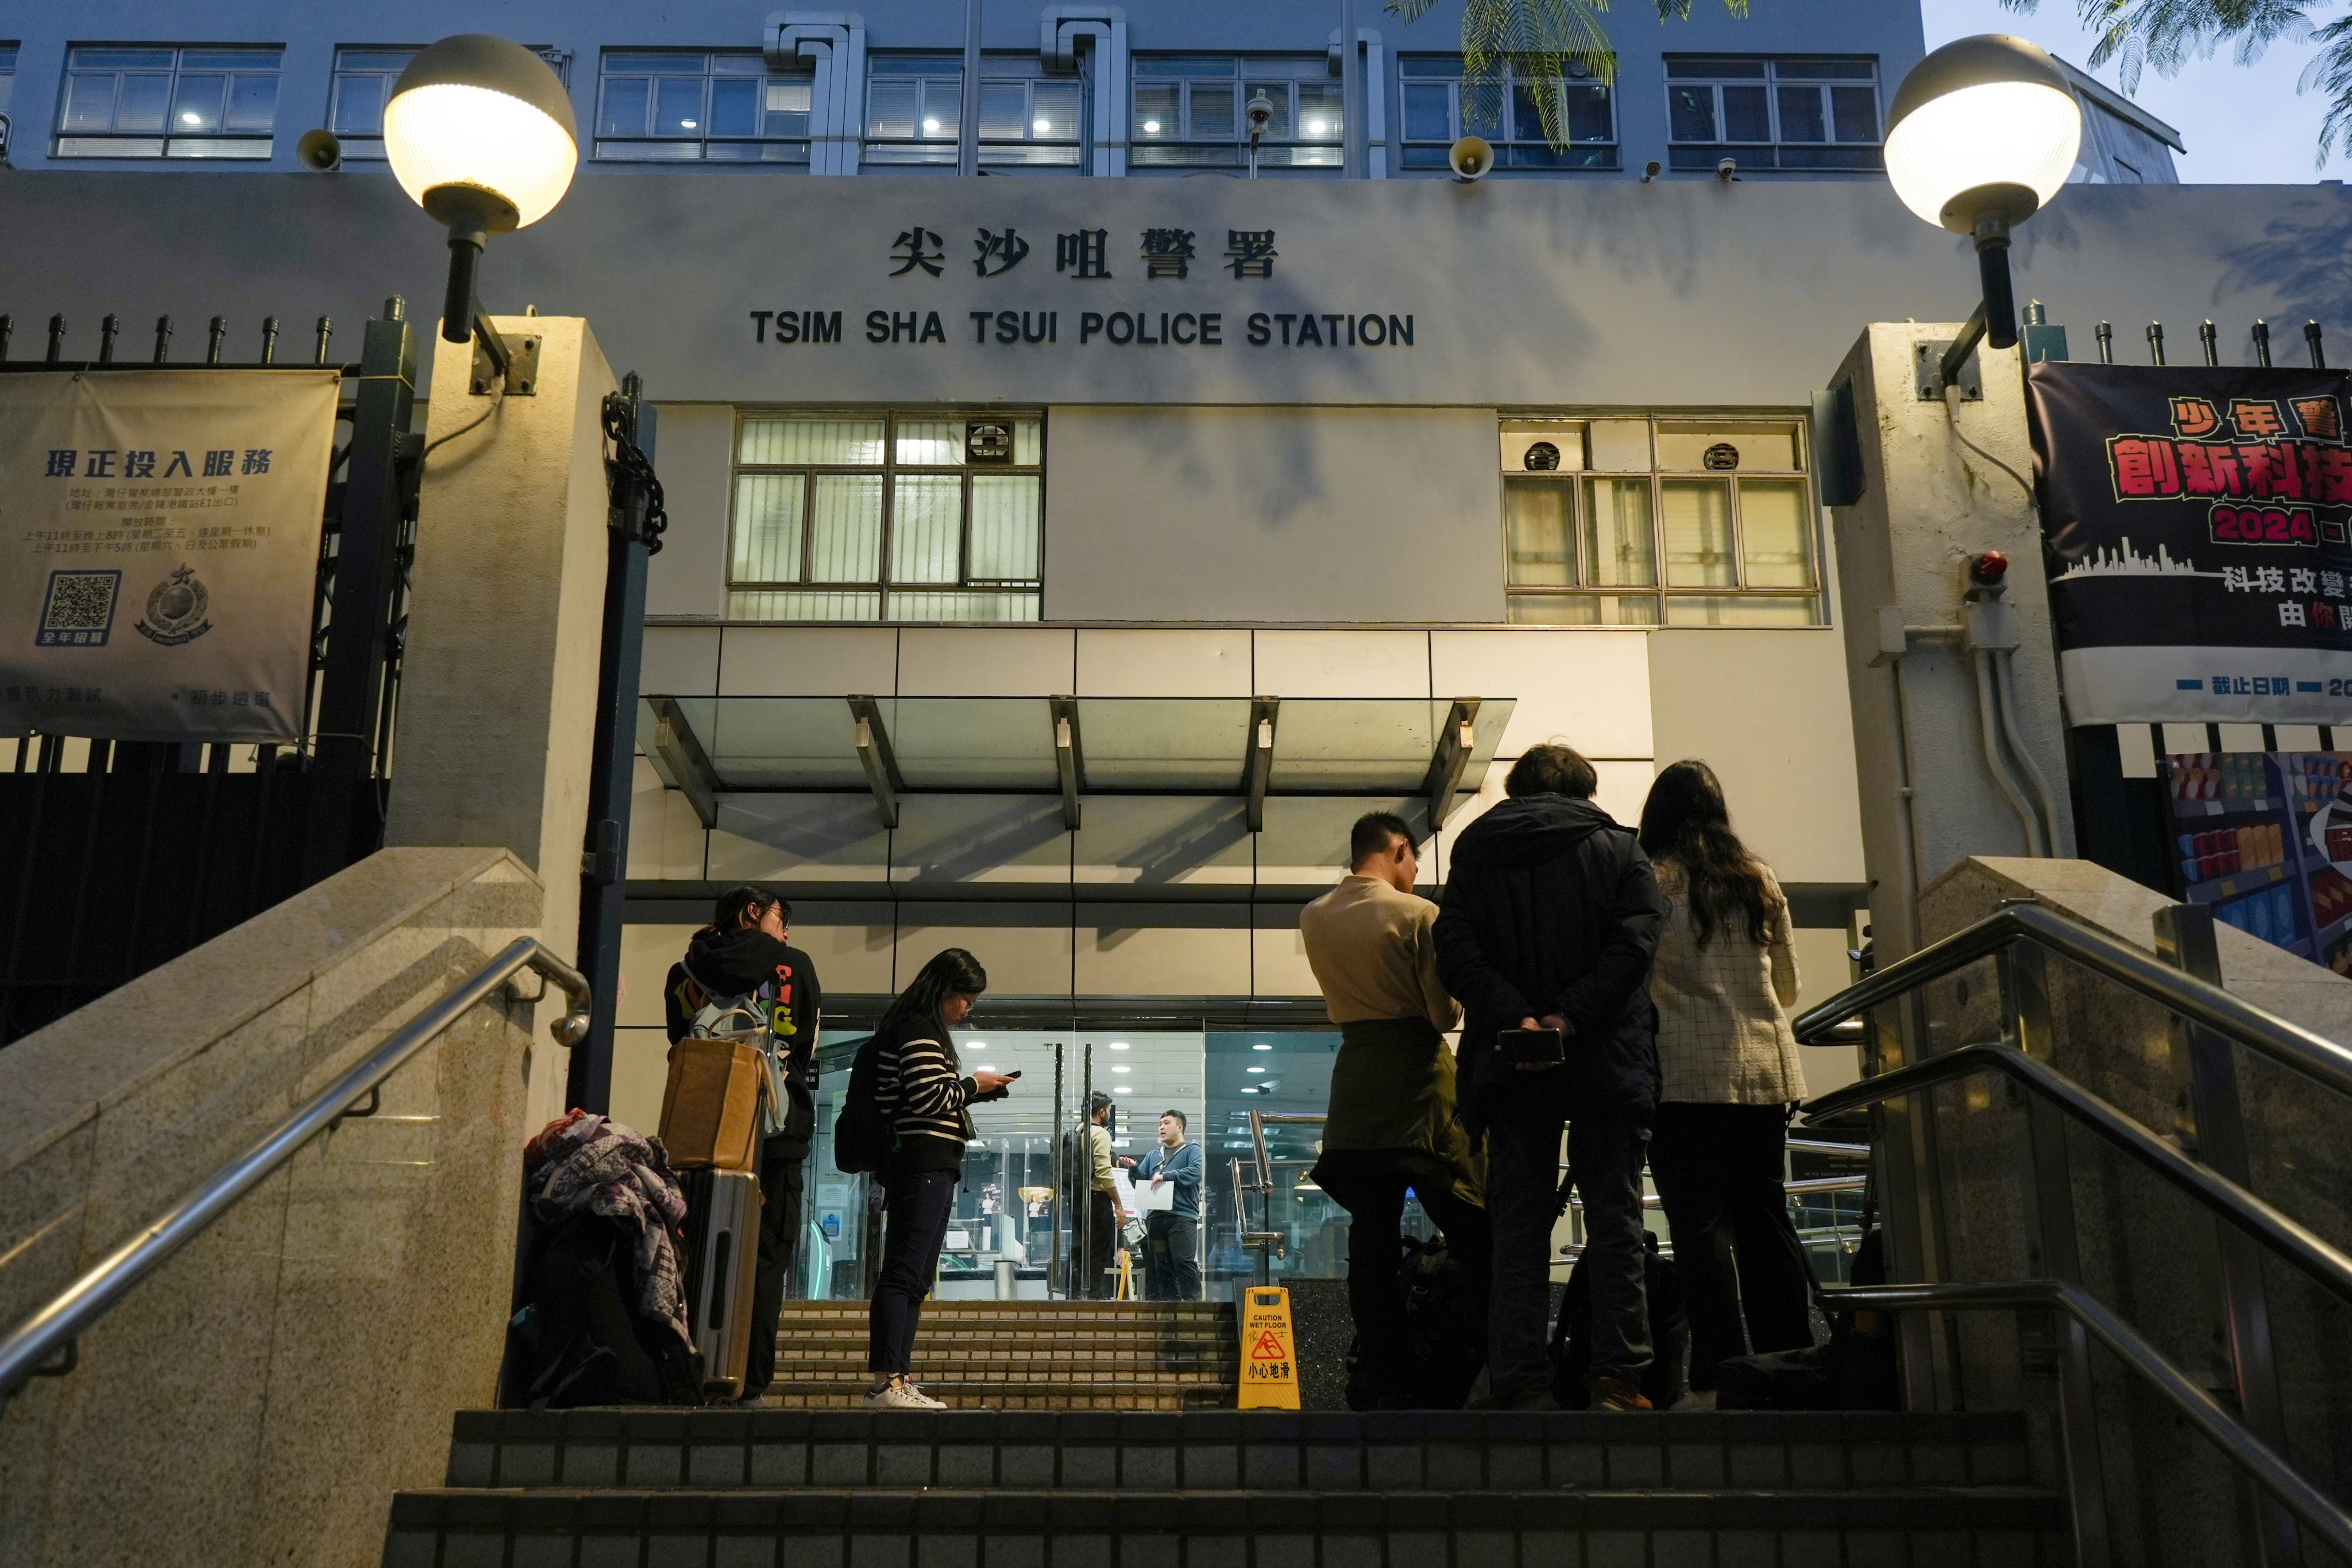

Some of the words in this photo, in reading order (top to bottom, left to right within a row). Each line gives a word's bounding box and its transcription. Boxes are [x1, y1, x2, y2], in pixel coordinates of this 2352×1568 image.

[889, 226, 1279, 280] 尖沙咀警署
[750, 311, 842, 343] TSIM
[866, 311, 947, 343] SHA
[970, 311, 1057, 345] TSUI
[1080, 312, 1222, 346] POLICE
[1247, 313, 1415, 347] STATION
[45, 449, 272, 478] 現正投入服務
[2114, 439, 2352, 503] 創新科技
[43, 632, 103, 644] 全年招募
[2212, 676, 2290, 696] 截止日期
[1249, 1362, 1289, 1379] 小心地滑
